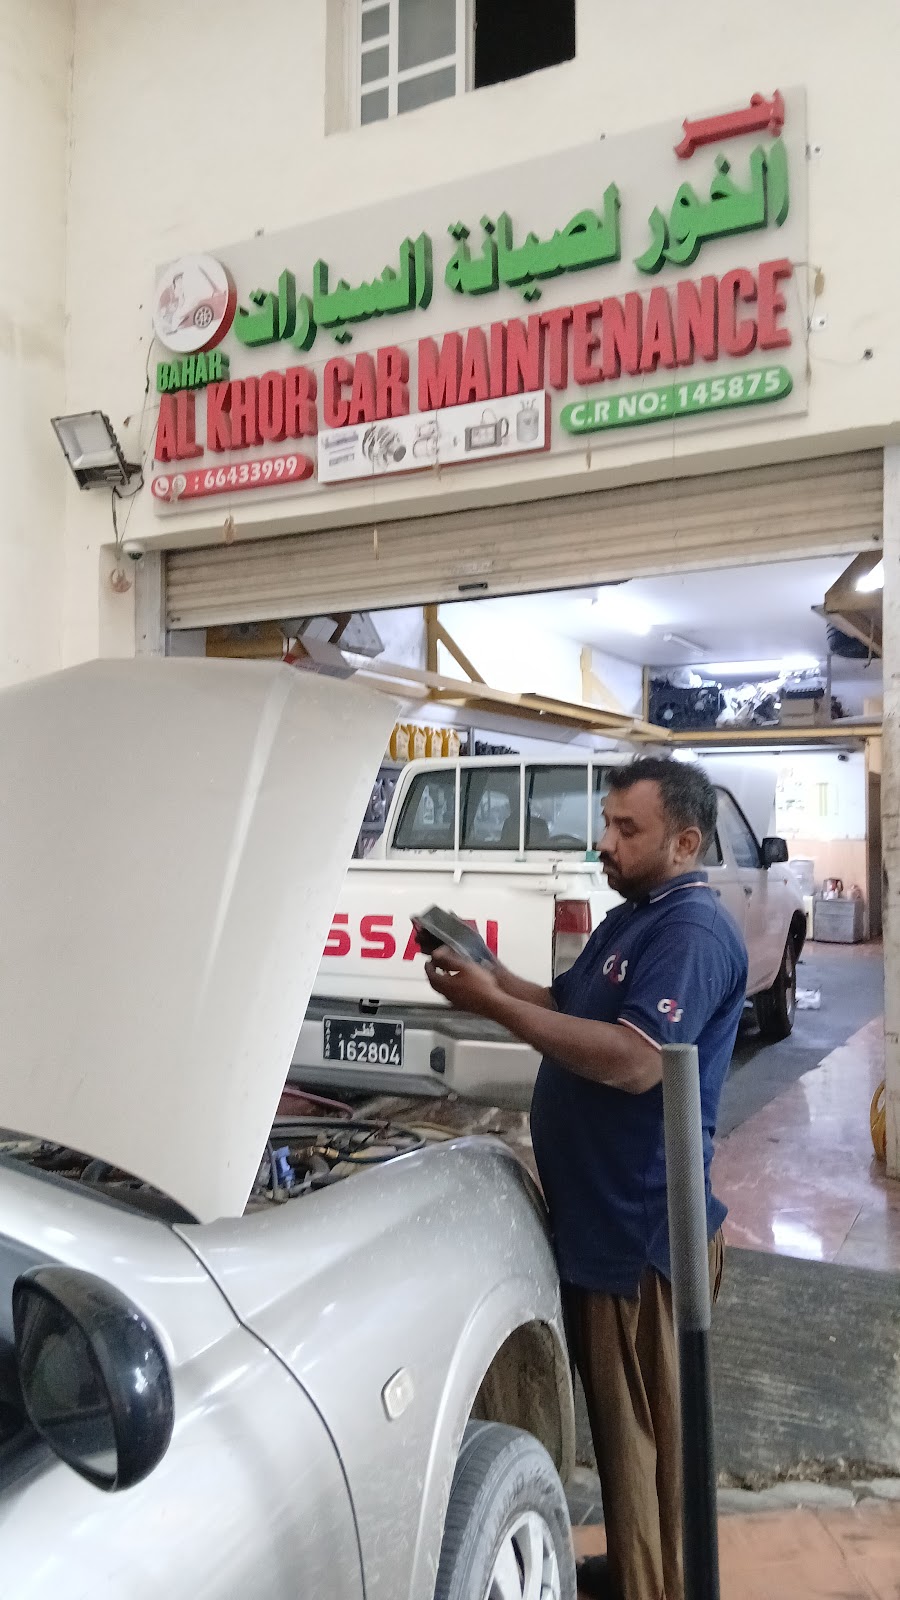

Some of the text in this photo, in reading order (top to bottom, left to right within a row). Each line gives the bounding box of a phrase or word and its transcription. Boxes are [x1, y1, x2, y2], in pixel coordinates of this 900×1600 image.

[234, 137, 790, 352] الخور لصيانة السيارات
[154, 258, 794, 462] AL KHOR CAR MAINTENANCE
[156, 350, 230, 394] BAHAR
[617, 391, 668, 419] NO:
[677, 367, 782, 409] 145875
[204, 455, 298, 490] 66433999
[338, 1039, 400, 1065] 162804
[350, 1022, 375, 1039] قطر
